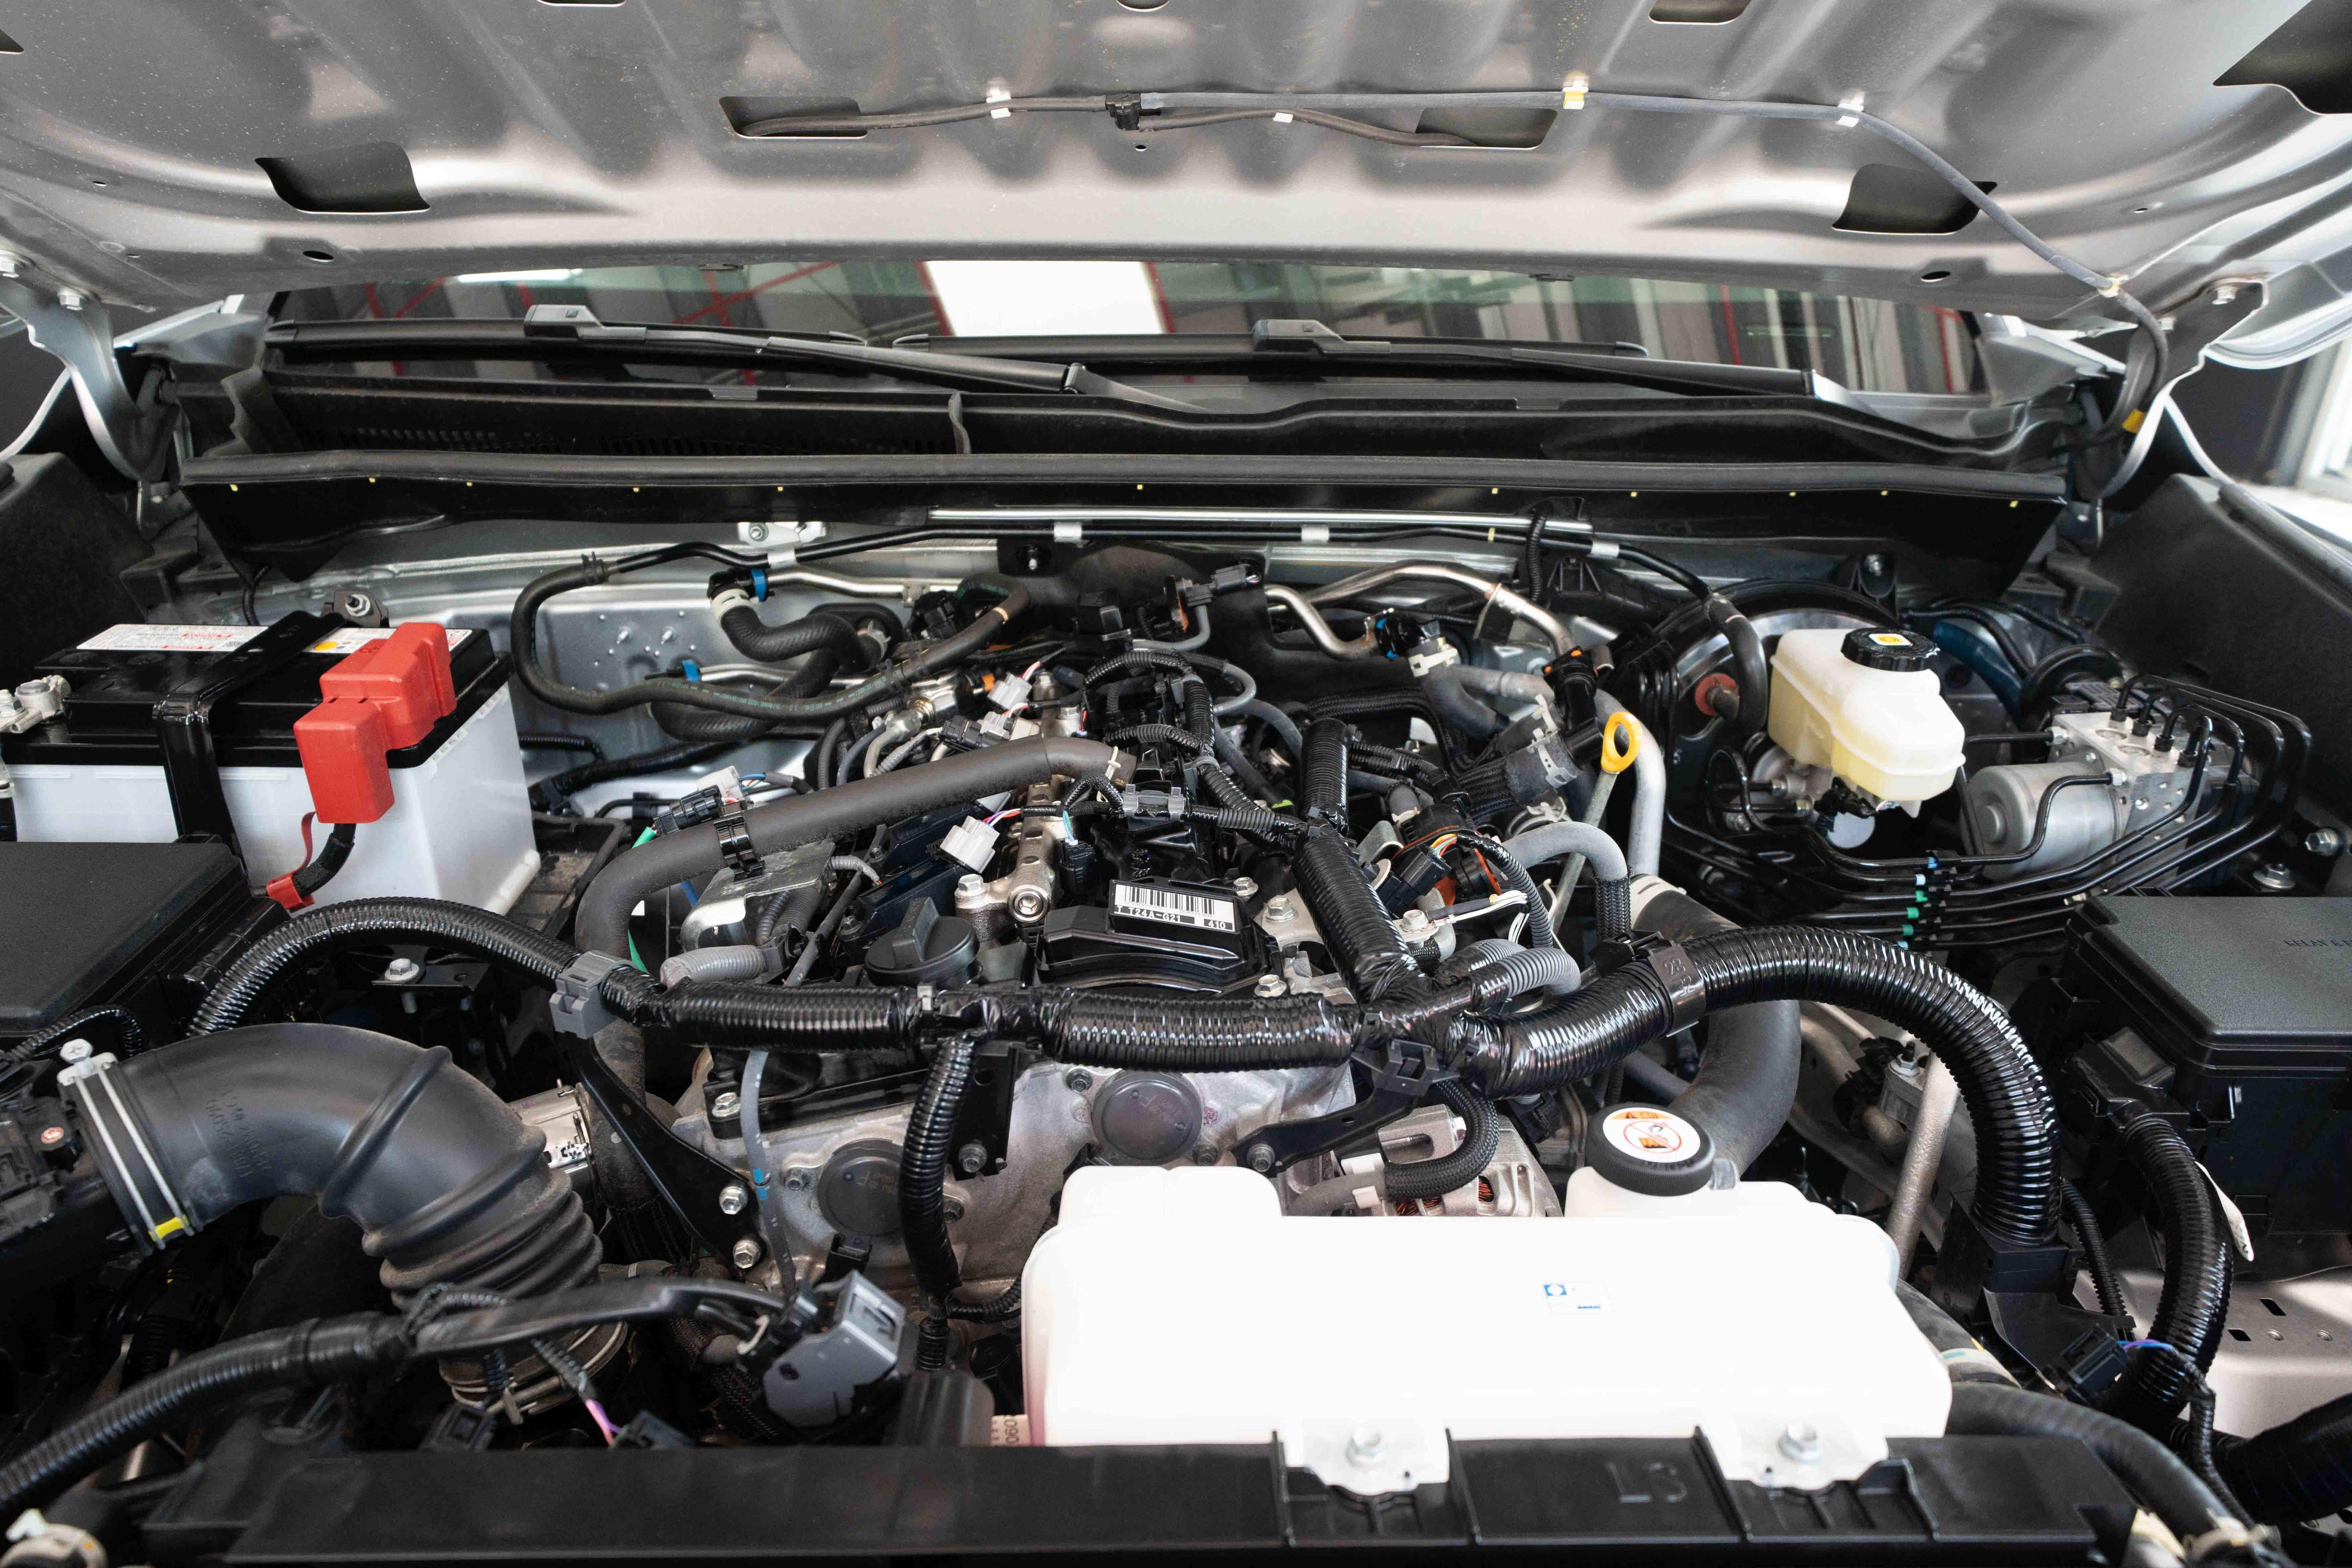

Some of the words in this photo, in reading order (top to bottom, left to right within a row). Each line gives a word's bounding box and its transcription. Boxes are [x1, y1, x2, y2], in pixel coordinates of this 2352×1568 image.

[926, 837, 944, 849] TOYOT
[1129, 907, 1180, 922] T24A-G21
[1208, 920, 1226, 929] 410
